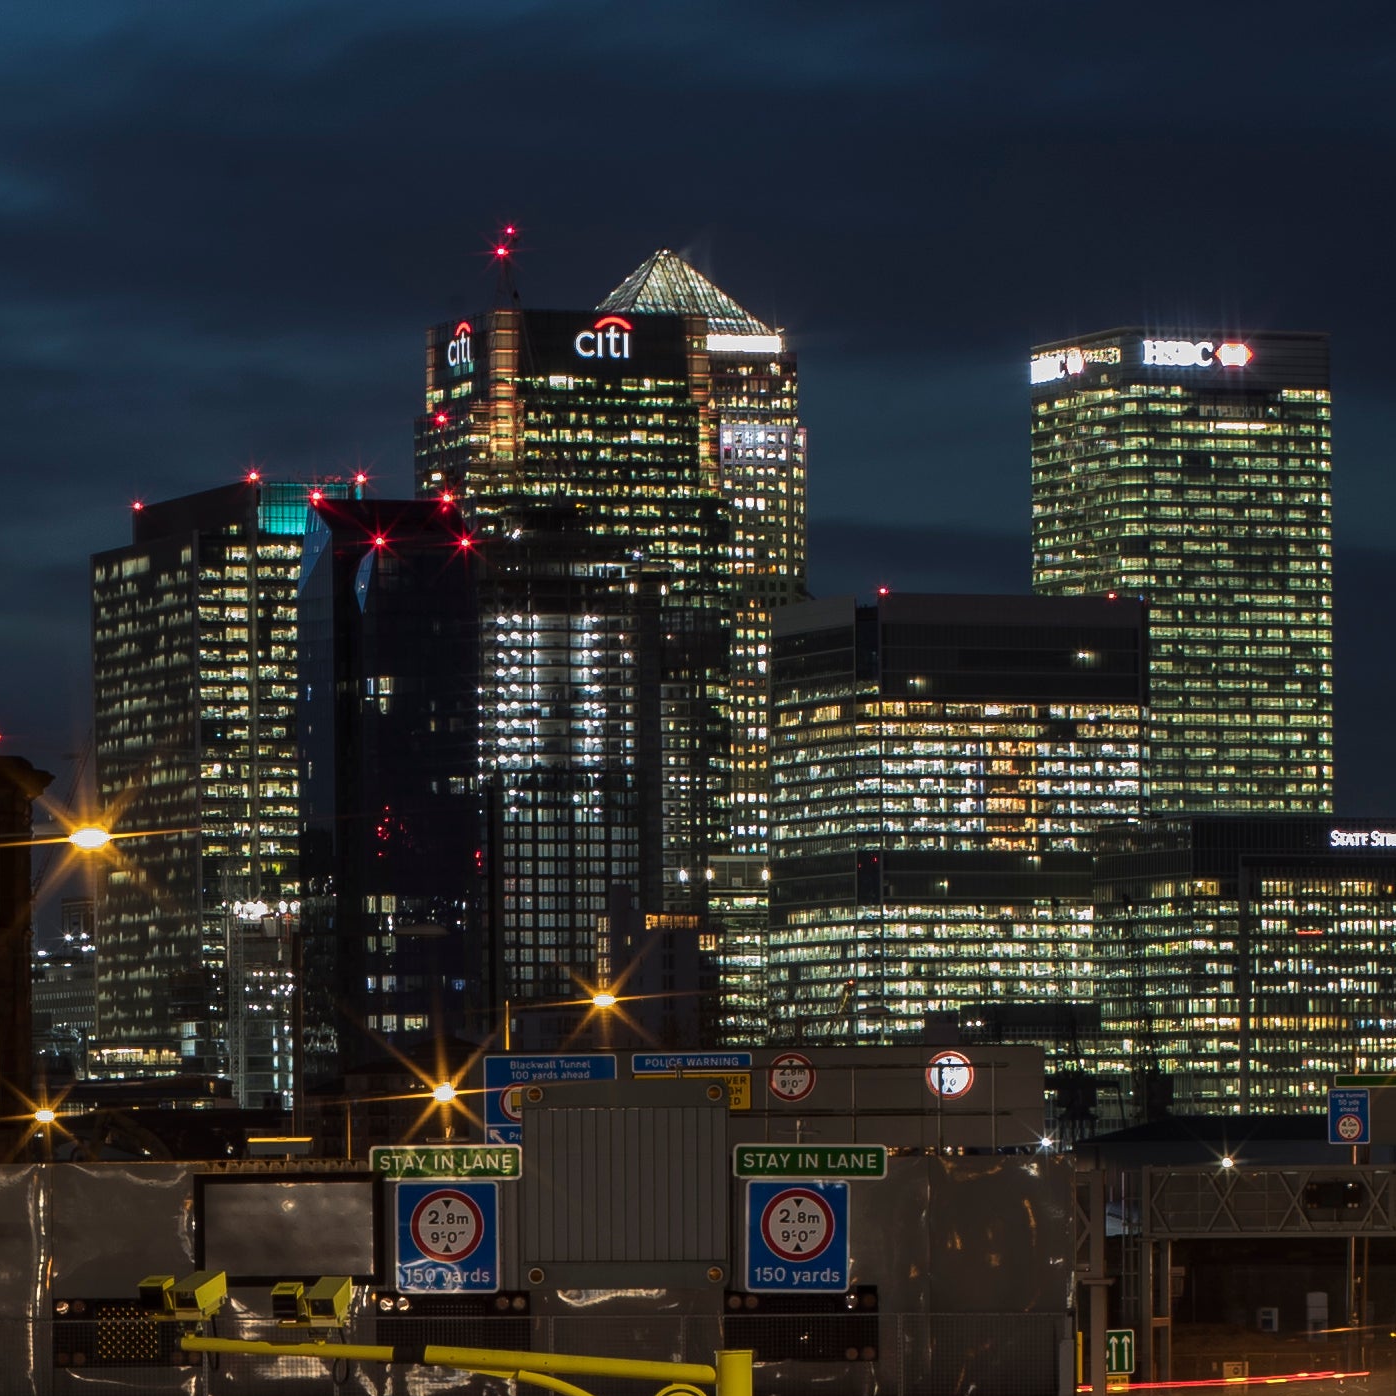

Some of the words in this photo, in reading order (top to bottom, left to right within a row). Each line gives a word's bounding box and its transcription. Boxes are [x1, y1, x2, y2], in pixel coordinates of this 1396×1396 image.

[447, 331, 472, 366] citi
[575, 325, 631, 359] citi
[510, 1060, 556, 1070] Blackwall
[559, 1060, 591, 1069] Tunnel
[645, 1058, 683, 1067] POLICE
[686, 1057, 739, 1066] WARNING
[511, 1071, 529, 1080] 100
[532, 1071, 558, 1080] yards
[561, 1070, 590, 1079] ahead
[379, 1154, 426, 1171] STAY
[434, 1154, 454, 1170] IN
[463, 1153, 513, 1170] LANE
[743, 1153, 791, 1169] STAY
[798, 1152, 819, 1169] IN
[827, 1152, 878, 1169] LANE
[428, 1210, 470, 1225] 2.8m
[779, 1209, 820, 1225] 2.8m
[406, 1268, 436, 1284] 150
[442, 1267, 491, 1287] yards
[754, 1267, 787, 1283] 150
[792, 1267, 841, 1286] yards
